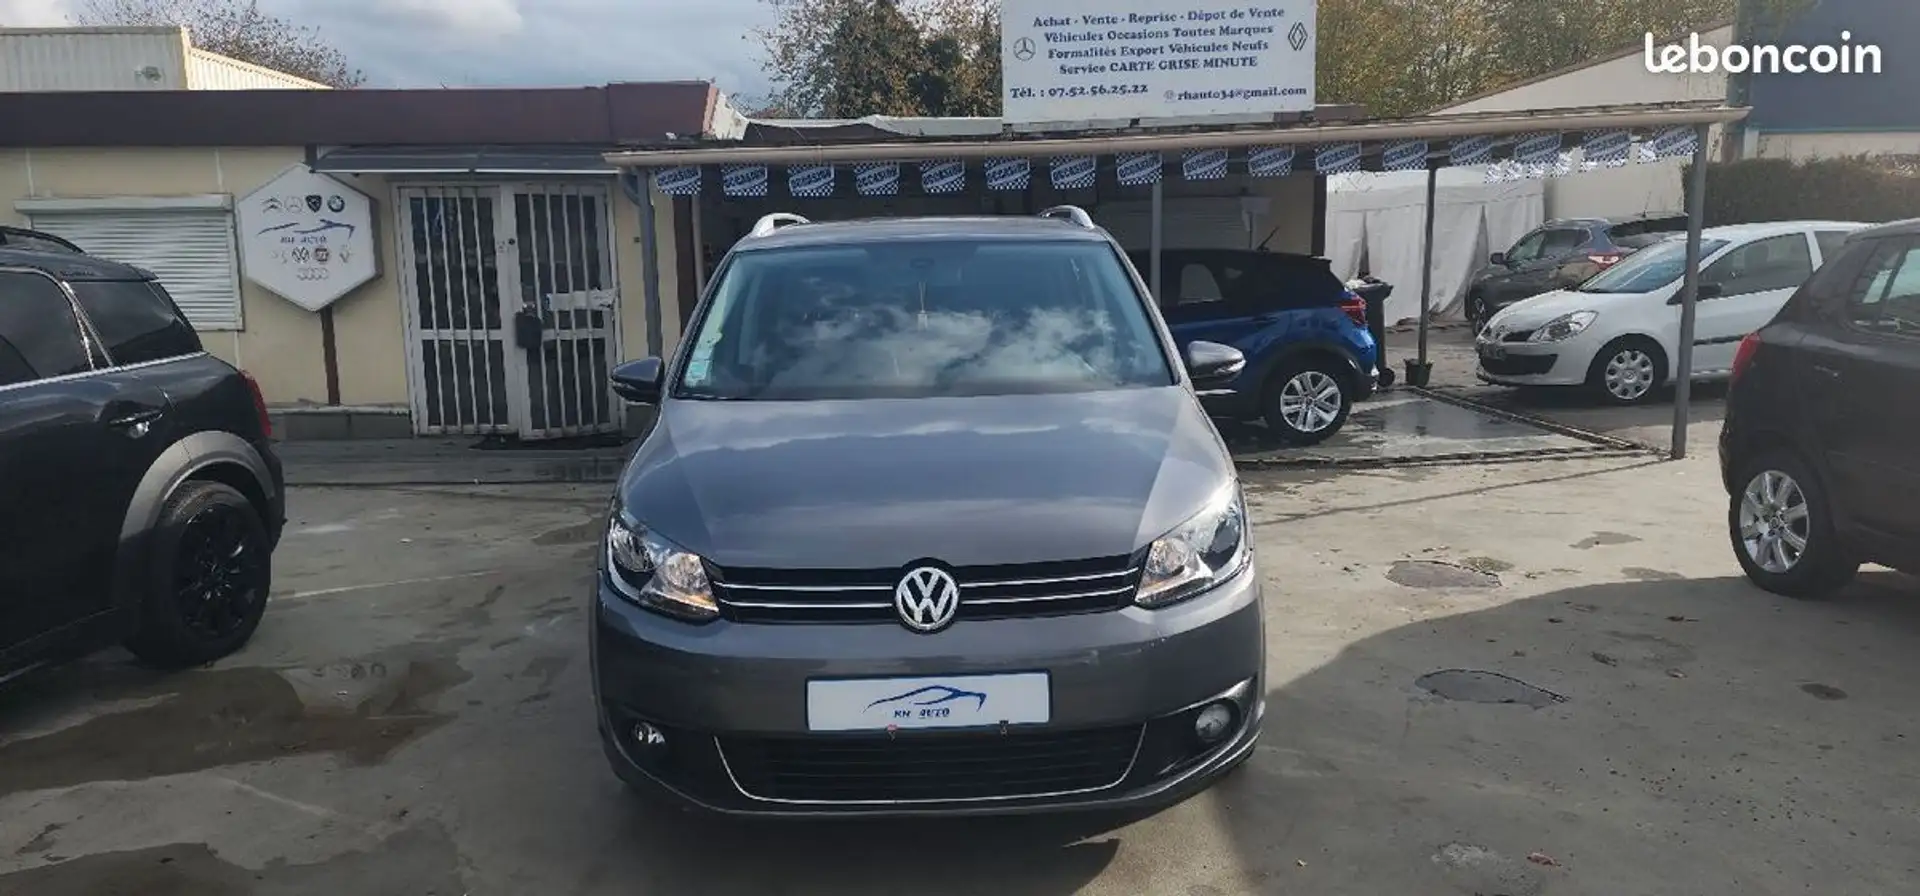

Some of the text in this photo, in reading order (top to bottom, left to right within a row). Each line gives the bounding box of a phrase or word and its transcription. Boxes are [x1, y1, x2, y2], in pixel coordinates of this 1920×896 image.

[1033, 16, 1071, 27] Achat
[1082, 15, 1118, 25] Vente
[1128, 13, 1177, 25] Reprise
[1230, 8, 1245, 19] de
[1249, 7, 1285, 18] Vente
[1107, 27, 1169, 40] Occasions
[1173, 26, 1216, 37] Toutes
[1219, 24, 1274, 37] Marques
[1120, 43, 1164, 57] Export
[1232, 40, 1269, 51] Neufs
[1060, 56, 1258, 75] Service CARTE GRISE MINUTE
